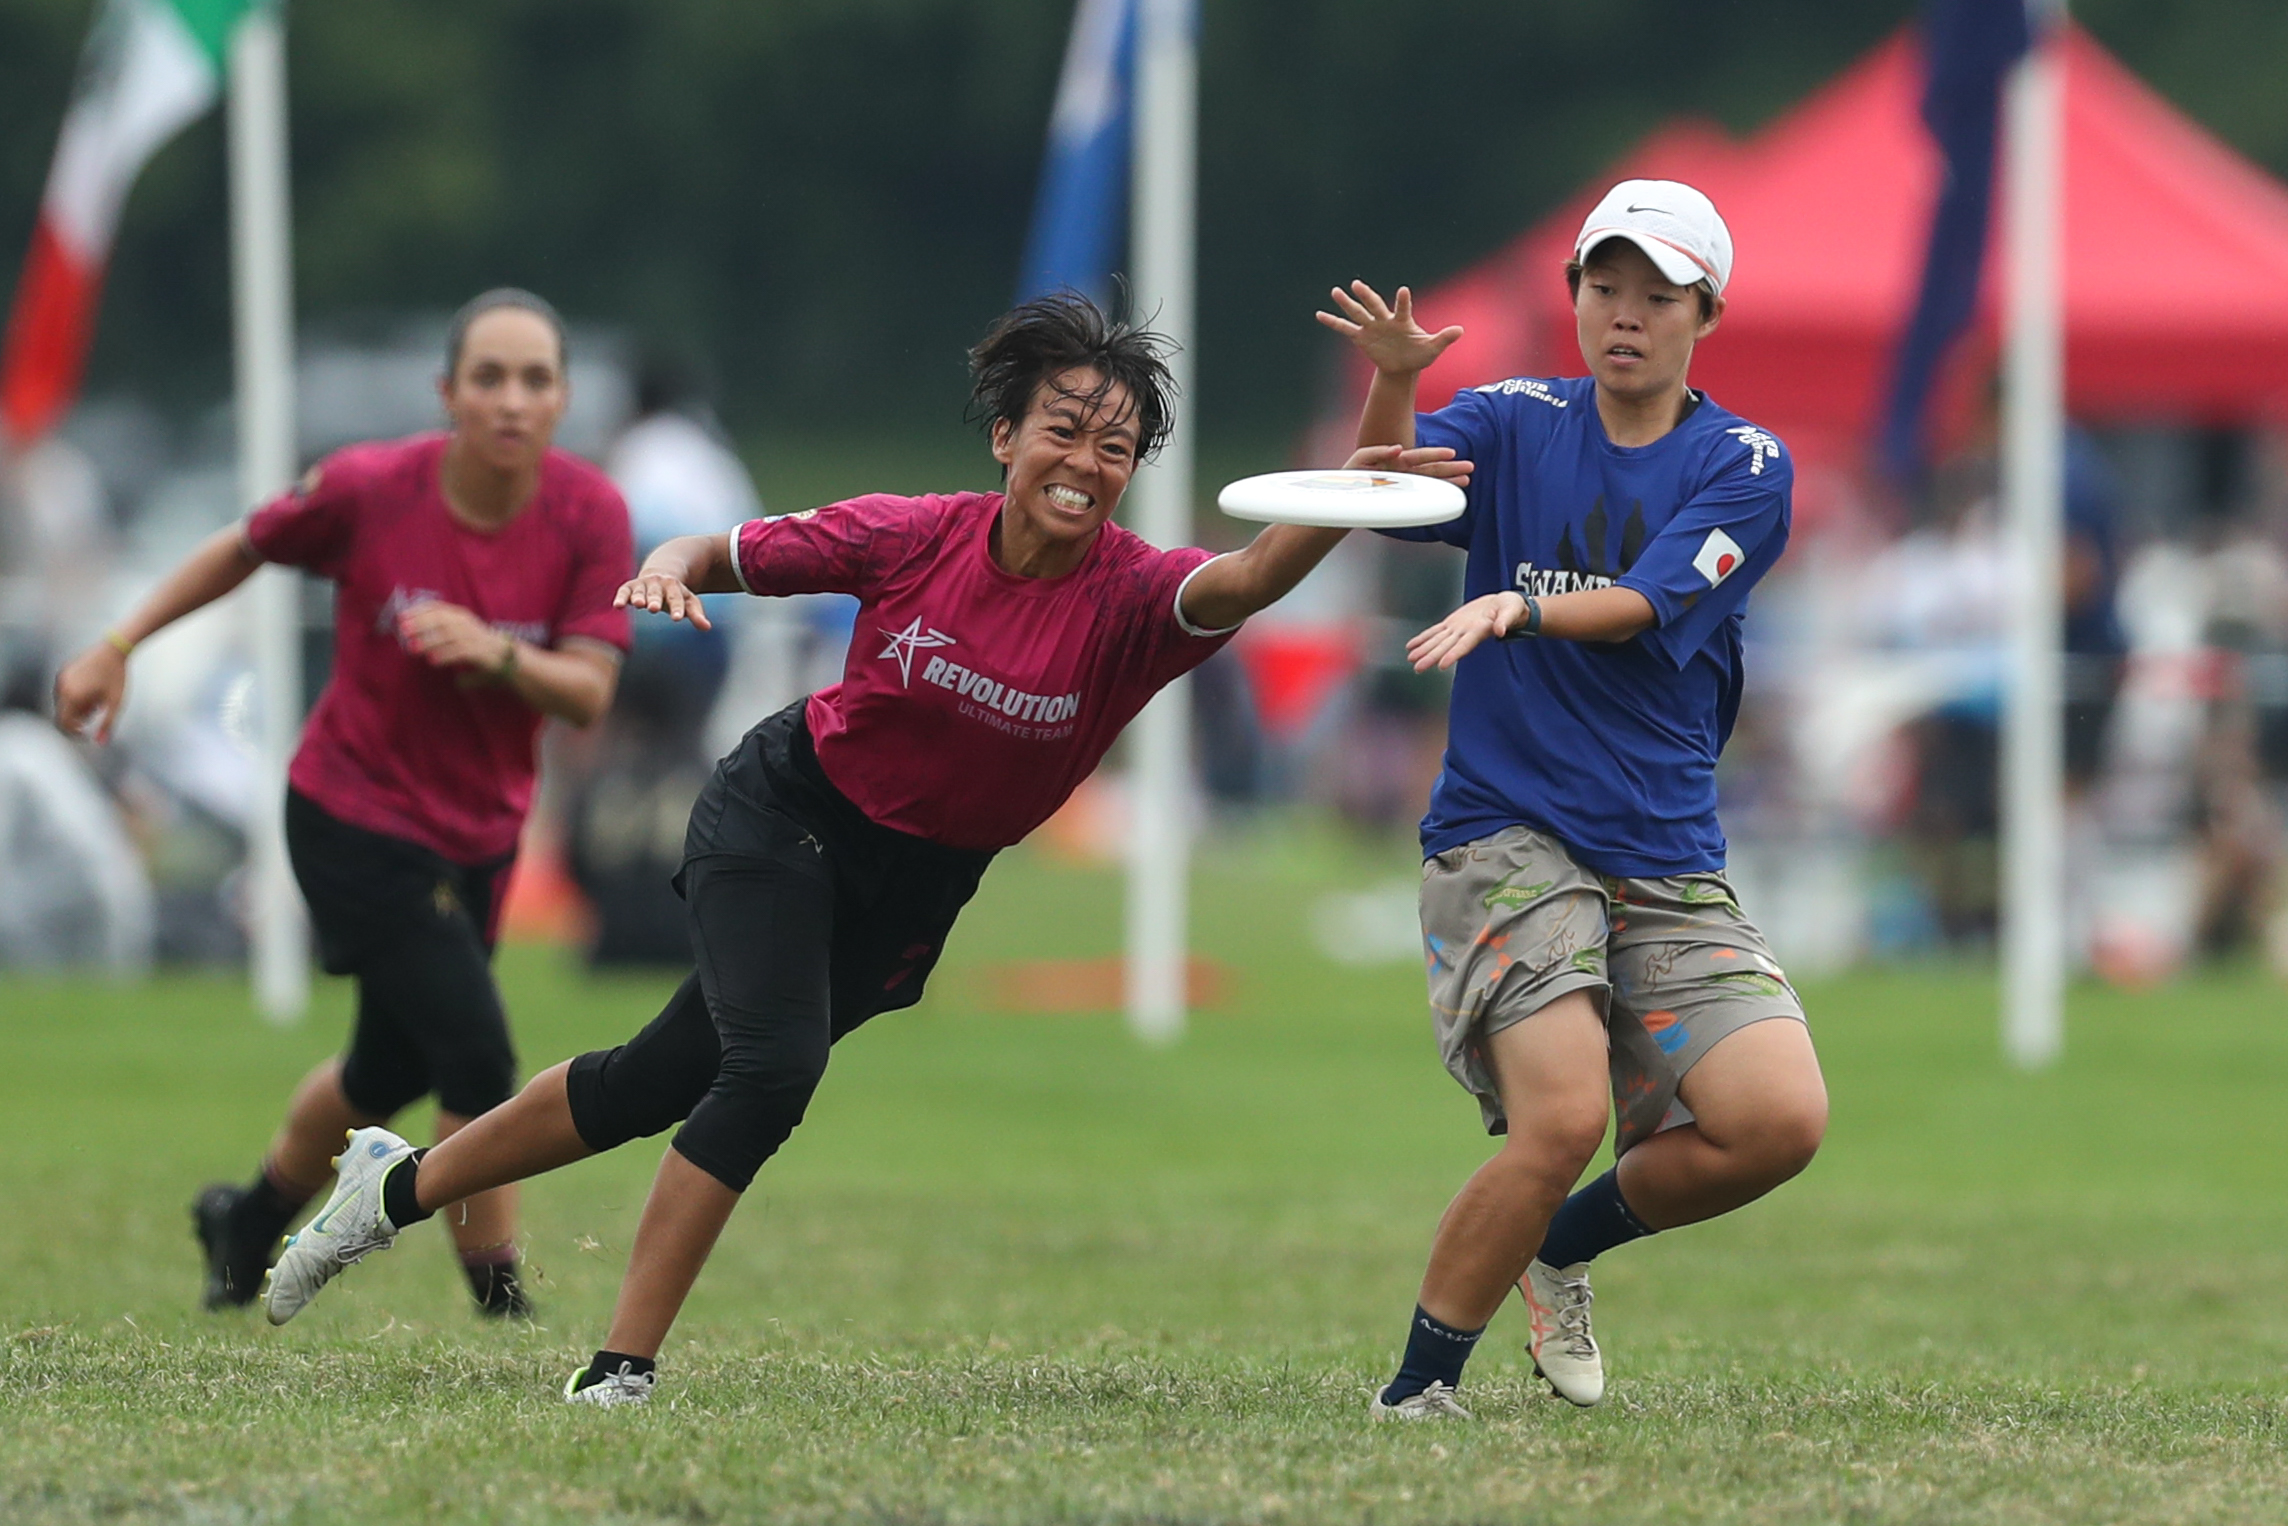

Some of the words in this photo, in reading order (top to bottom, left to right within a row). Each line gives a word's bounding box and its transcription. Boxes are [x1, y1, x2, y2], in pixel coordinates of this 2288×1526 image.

[1515, 562, 1616, 597] SWAMP
[921, 655, 1081, 723] REVOLUTION
[957, 701, 1031, 739] ULTIMATE
[1034, 723, 1074, 741] TEAM
